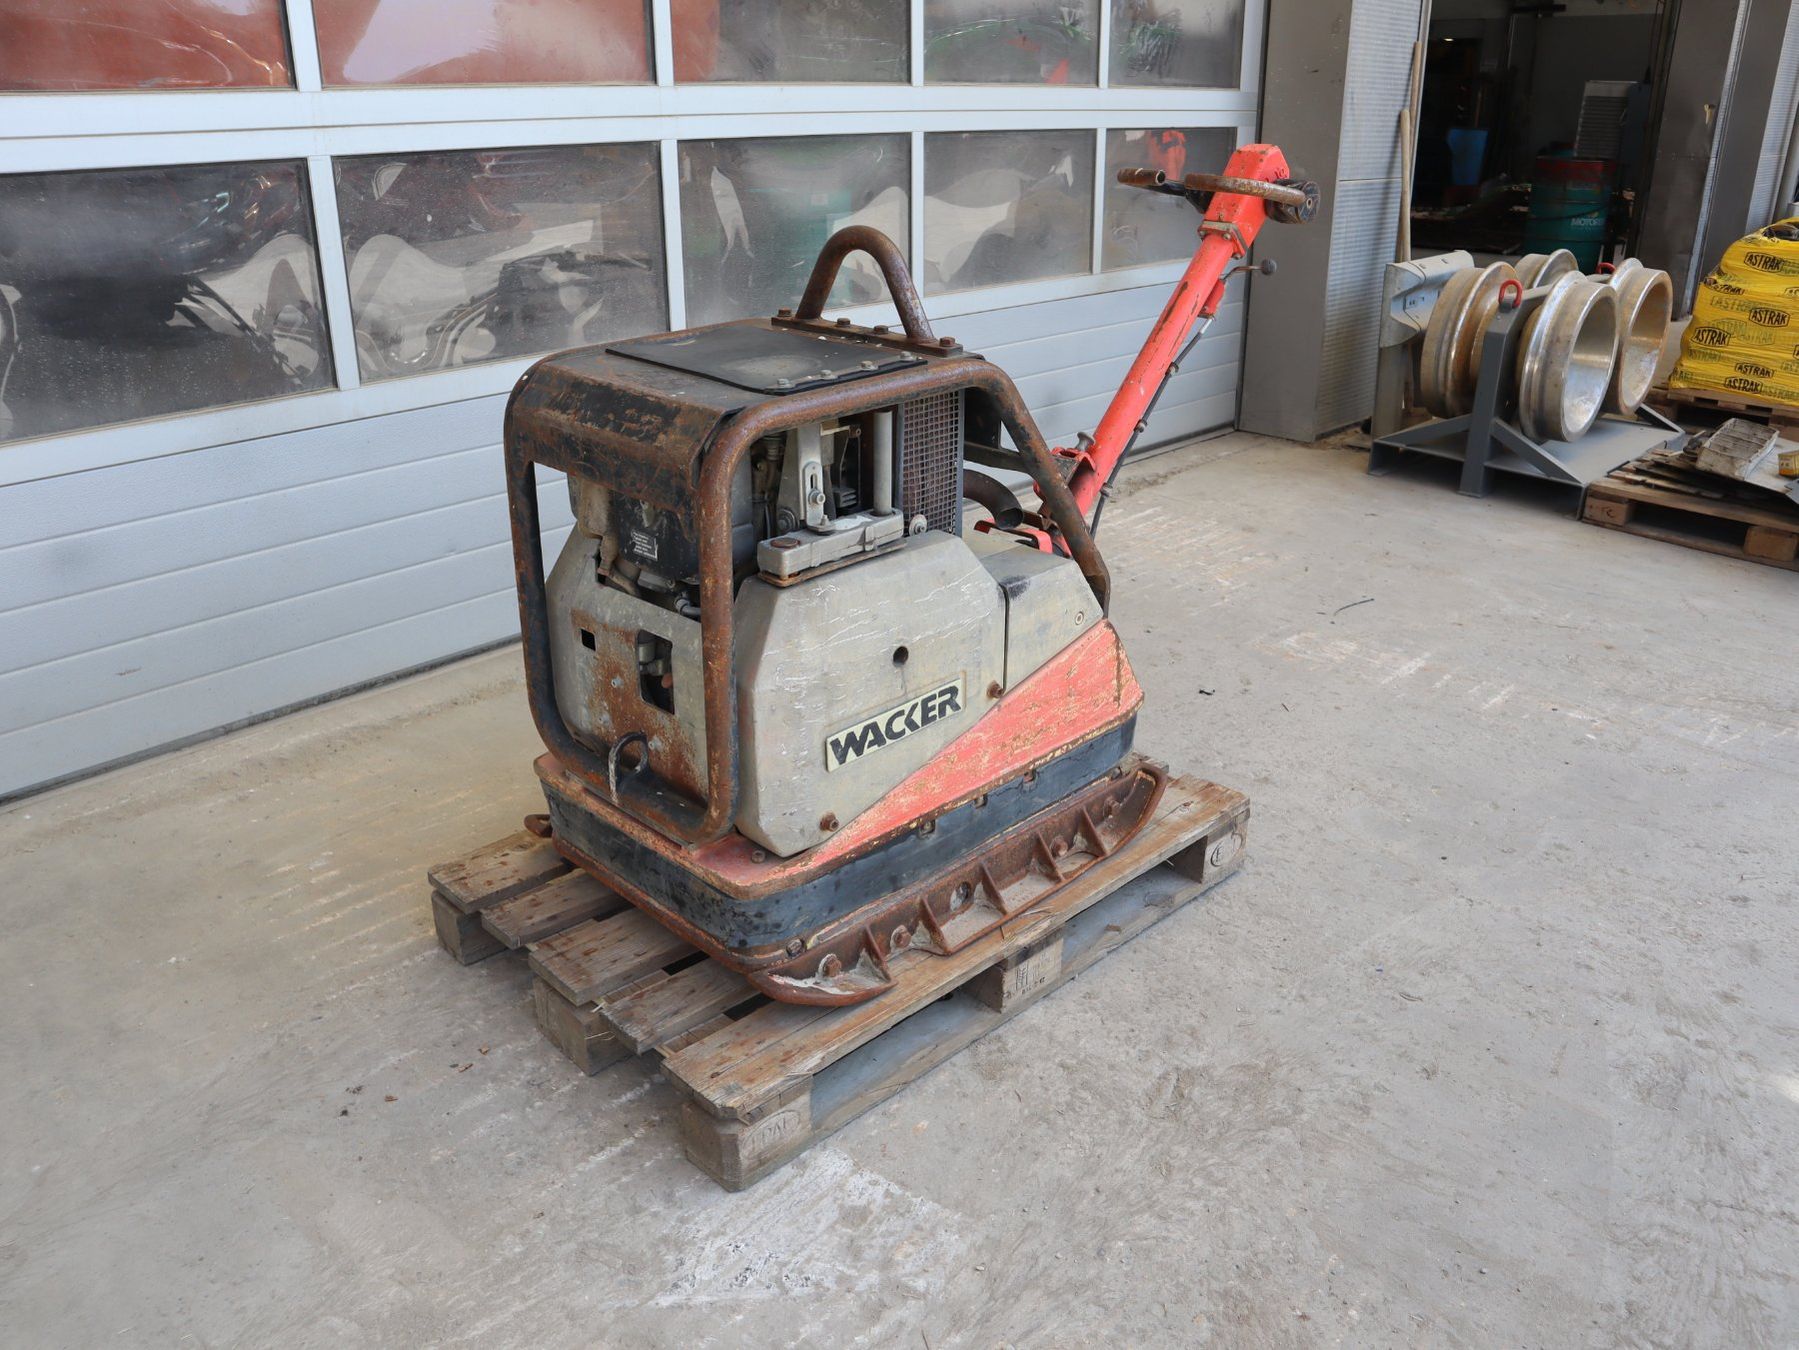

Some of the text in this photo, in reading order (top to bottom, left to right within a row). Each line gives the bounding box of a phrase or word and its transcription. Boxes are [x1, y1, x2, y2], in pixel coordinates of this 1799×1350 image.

[1747, 254, 1781, 271] ASTRAK
[1751, 307, 1787, 325] ASTRAK
[1694, 328, 1728, 346] ASTRAK
[1737, 364, 1771, 378] ASTRAK
[1726, 378, 1760, 393] ASTRAK
[829, 684, 962, 765] WACKER
